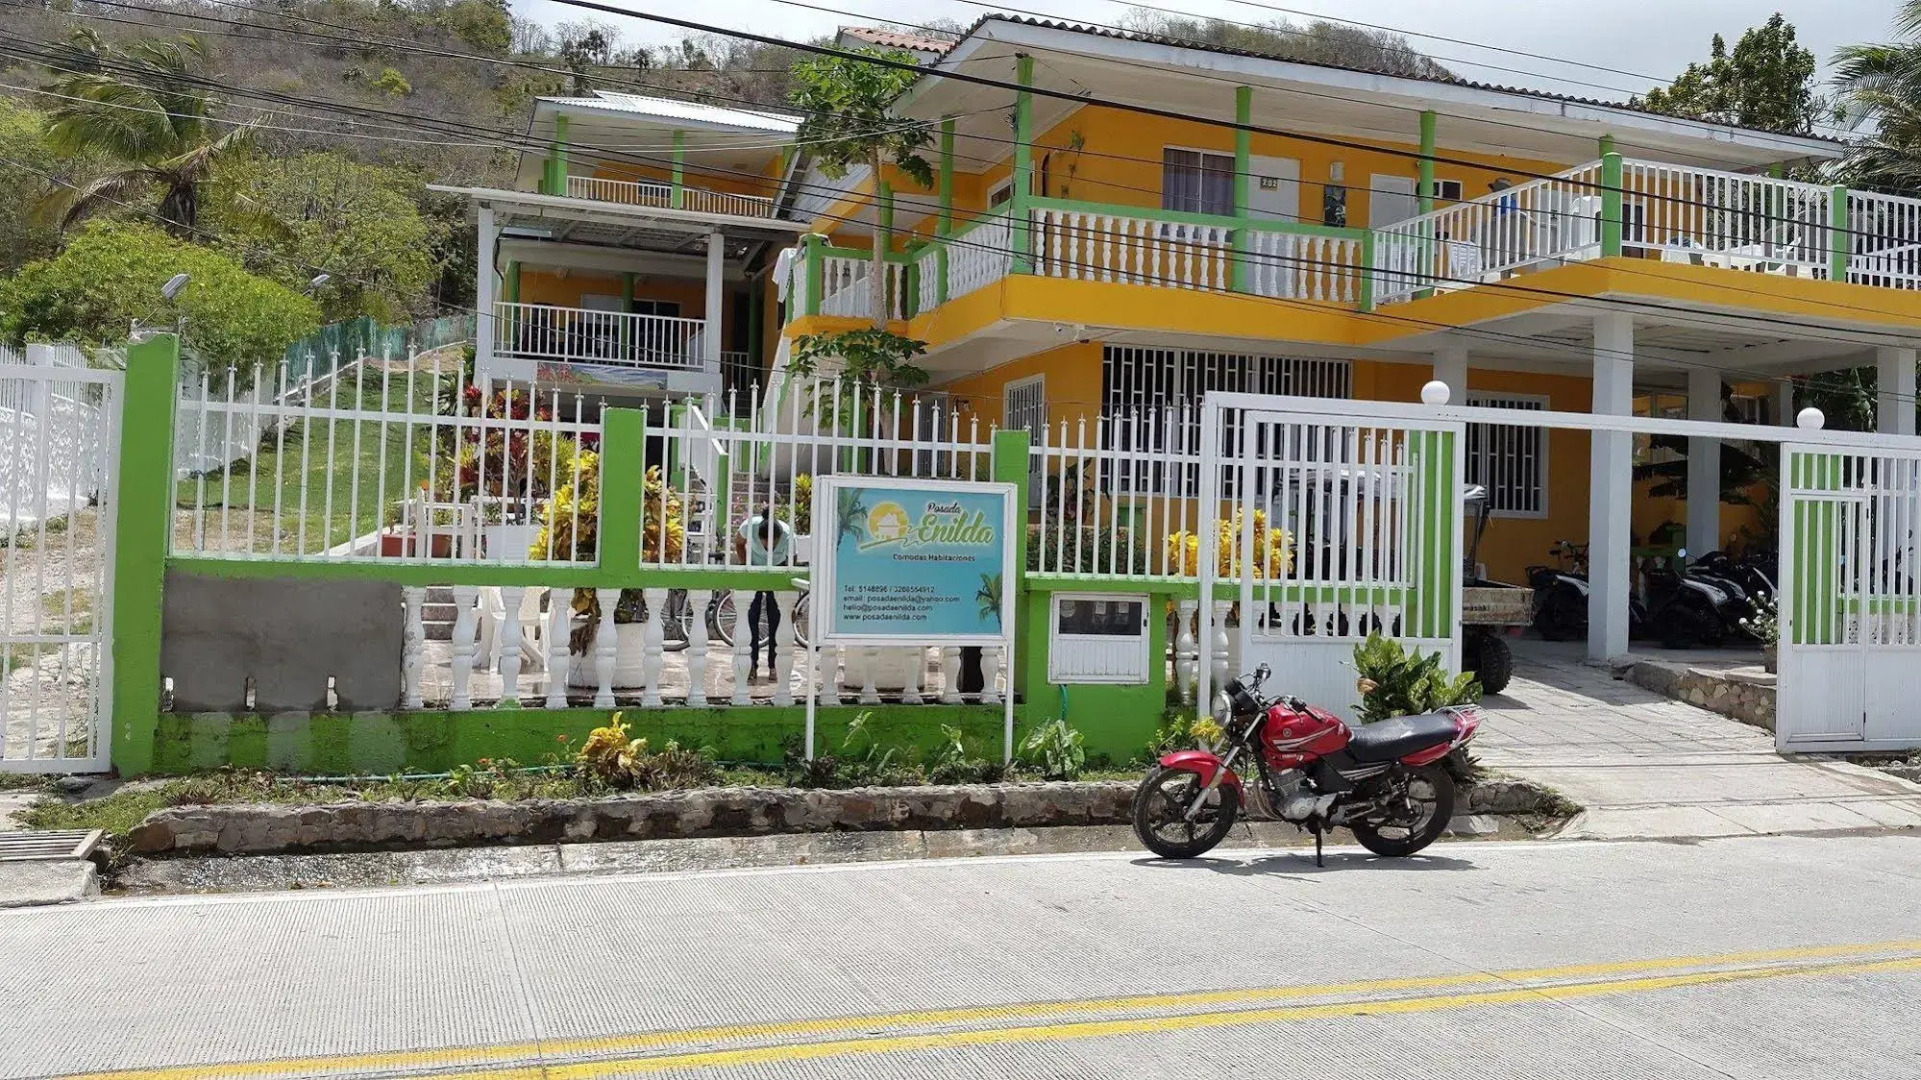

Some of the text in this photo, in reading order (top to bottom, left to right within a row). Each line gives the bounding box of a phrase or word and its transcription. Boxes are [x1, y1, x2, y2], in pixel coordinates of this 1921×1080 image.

[927, 502, 961, 514] Posada
[918, 511, 993, 543] Enilda
[892, 553, 976, 562] Comodas Habitaciones
[867, 595, 960, 604] posadaenilda@yahoo.com
[843, 604, 933, 613] hello@posadaenilda.com
